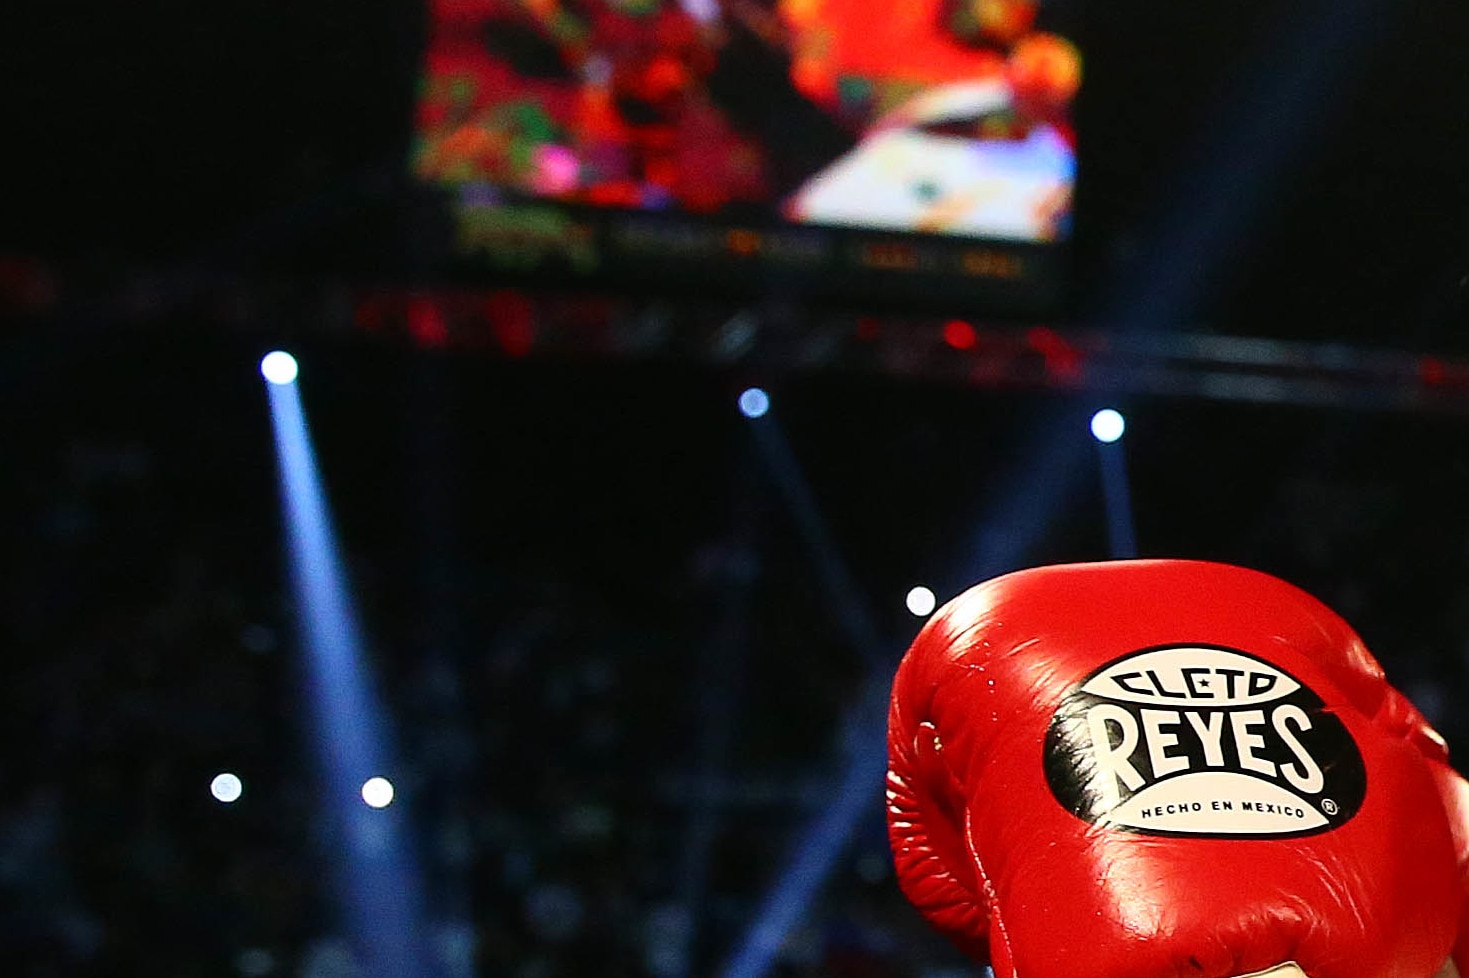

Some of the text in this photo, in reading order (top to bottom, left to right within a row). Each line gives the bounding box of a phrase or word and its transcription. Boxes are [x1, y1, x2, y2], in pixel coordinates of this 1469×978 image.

[1087, 703, 1325, 801] REYES
[1141, 800, 1306, 819] HECHO EN MEXICO
